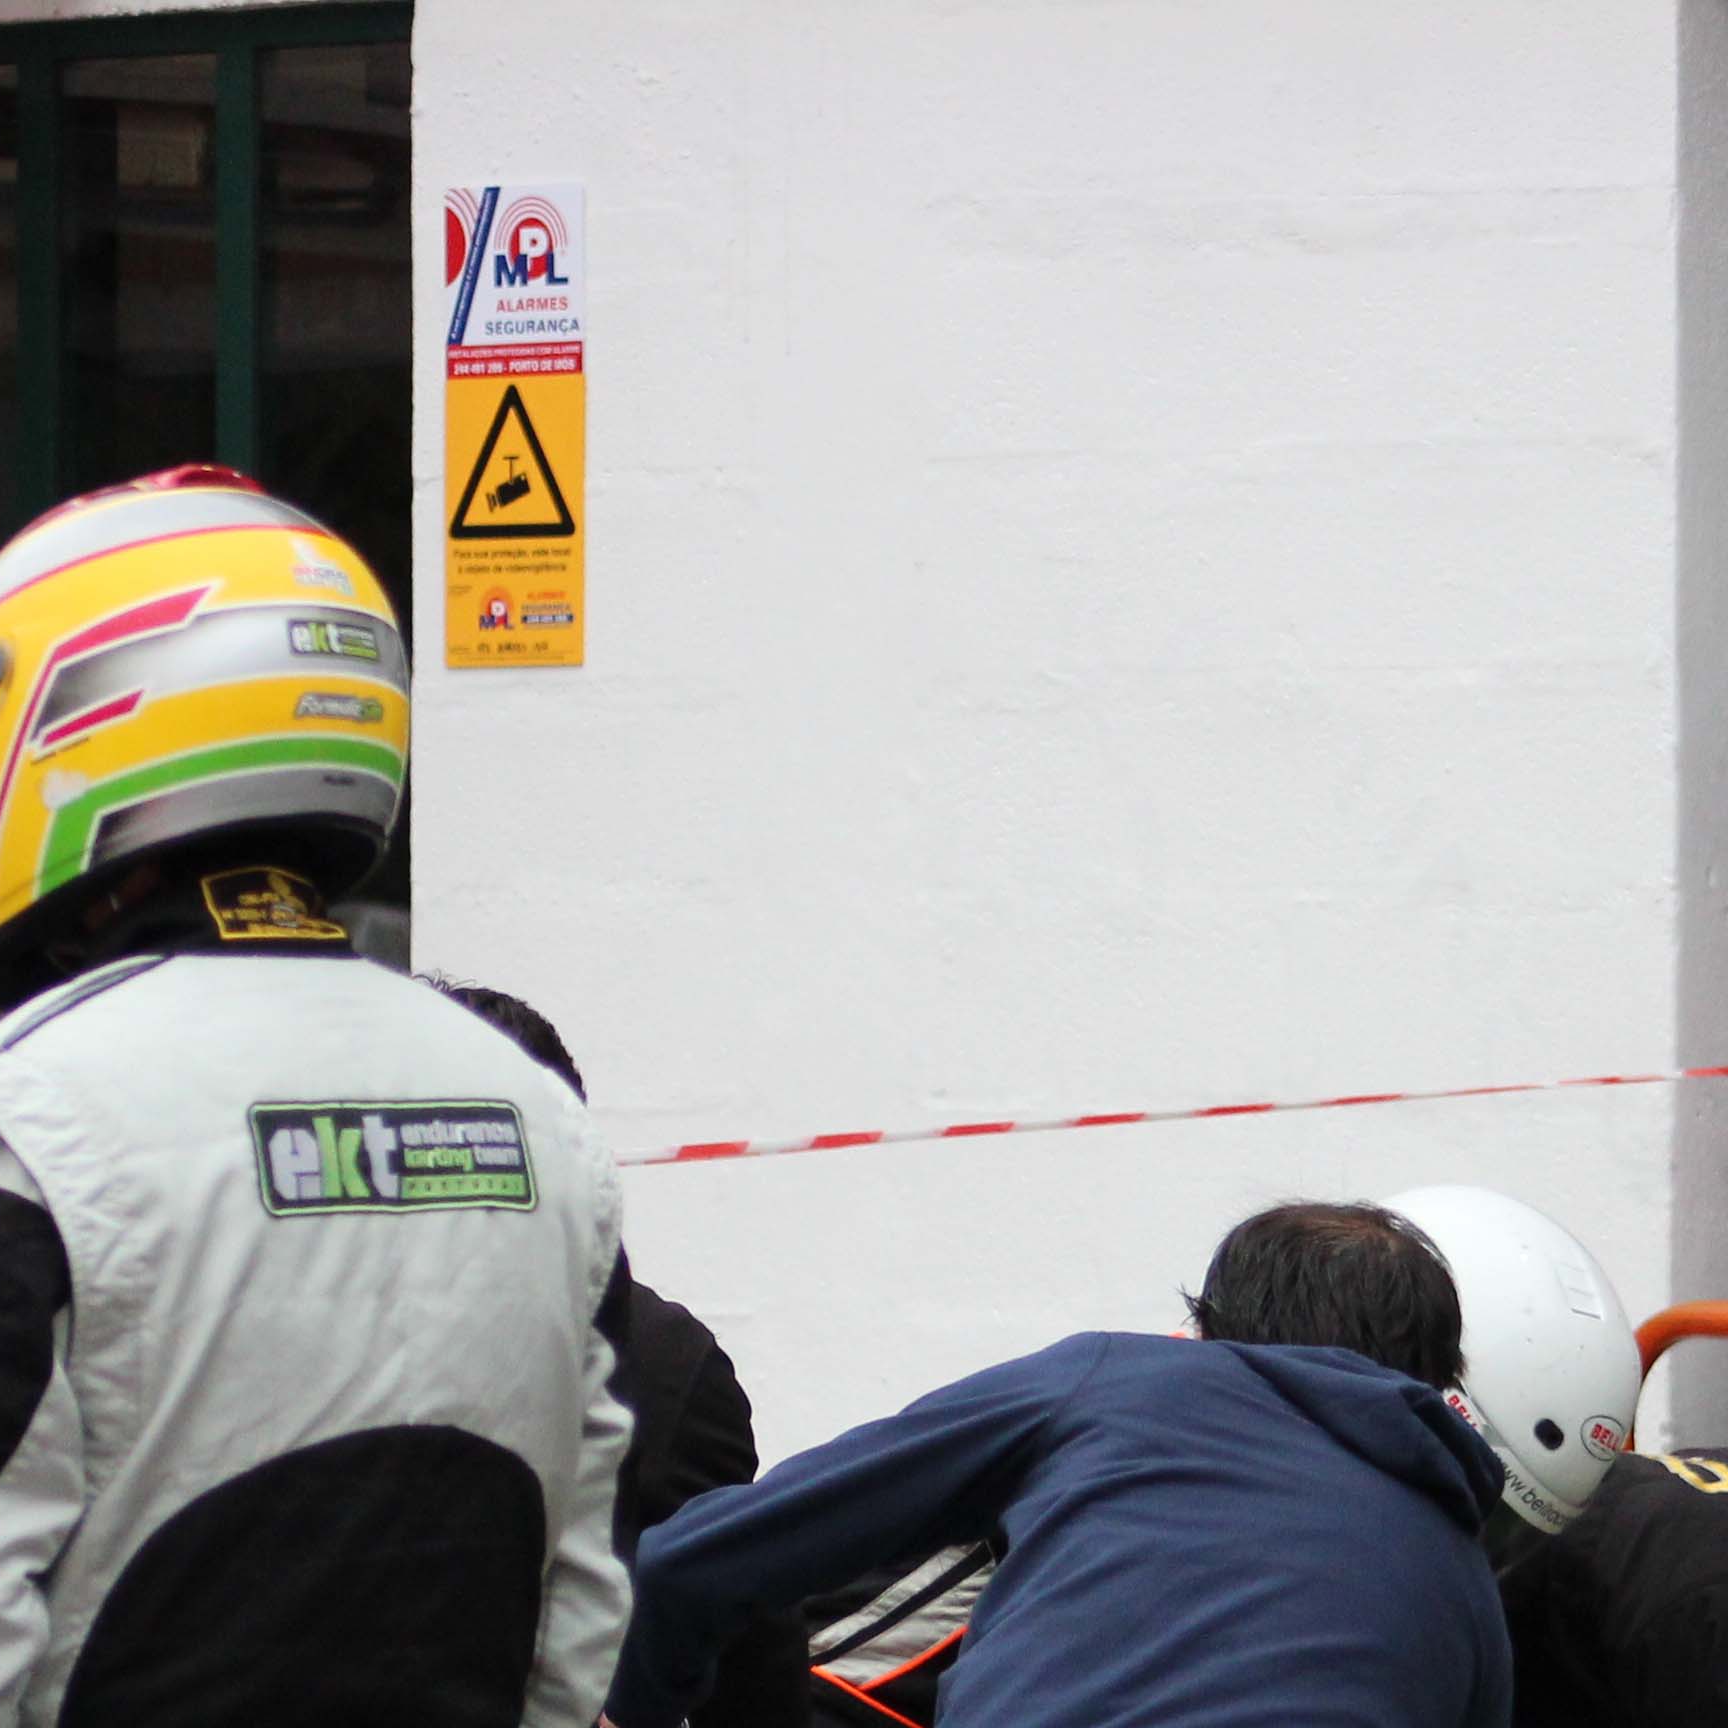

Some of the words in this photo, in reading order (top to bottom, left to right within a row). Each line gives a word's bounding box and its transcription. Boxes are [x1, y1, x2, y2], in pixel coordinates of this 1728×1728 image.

[496, 296, 569, 313] ALARMES
[485, 317, 580, 336] SEGURANÇA
[268, 1114, 398, 1200] ekt
